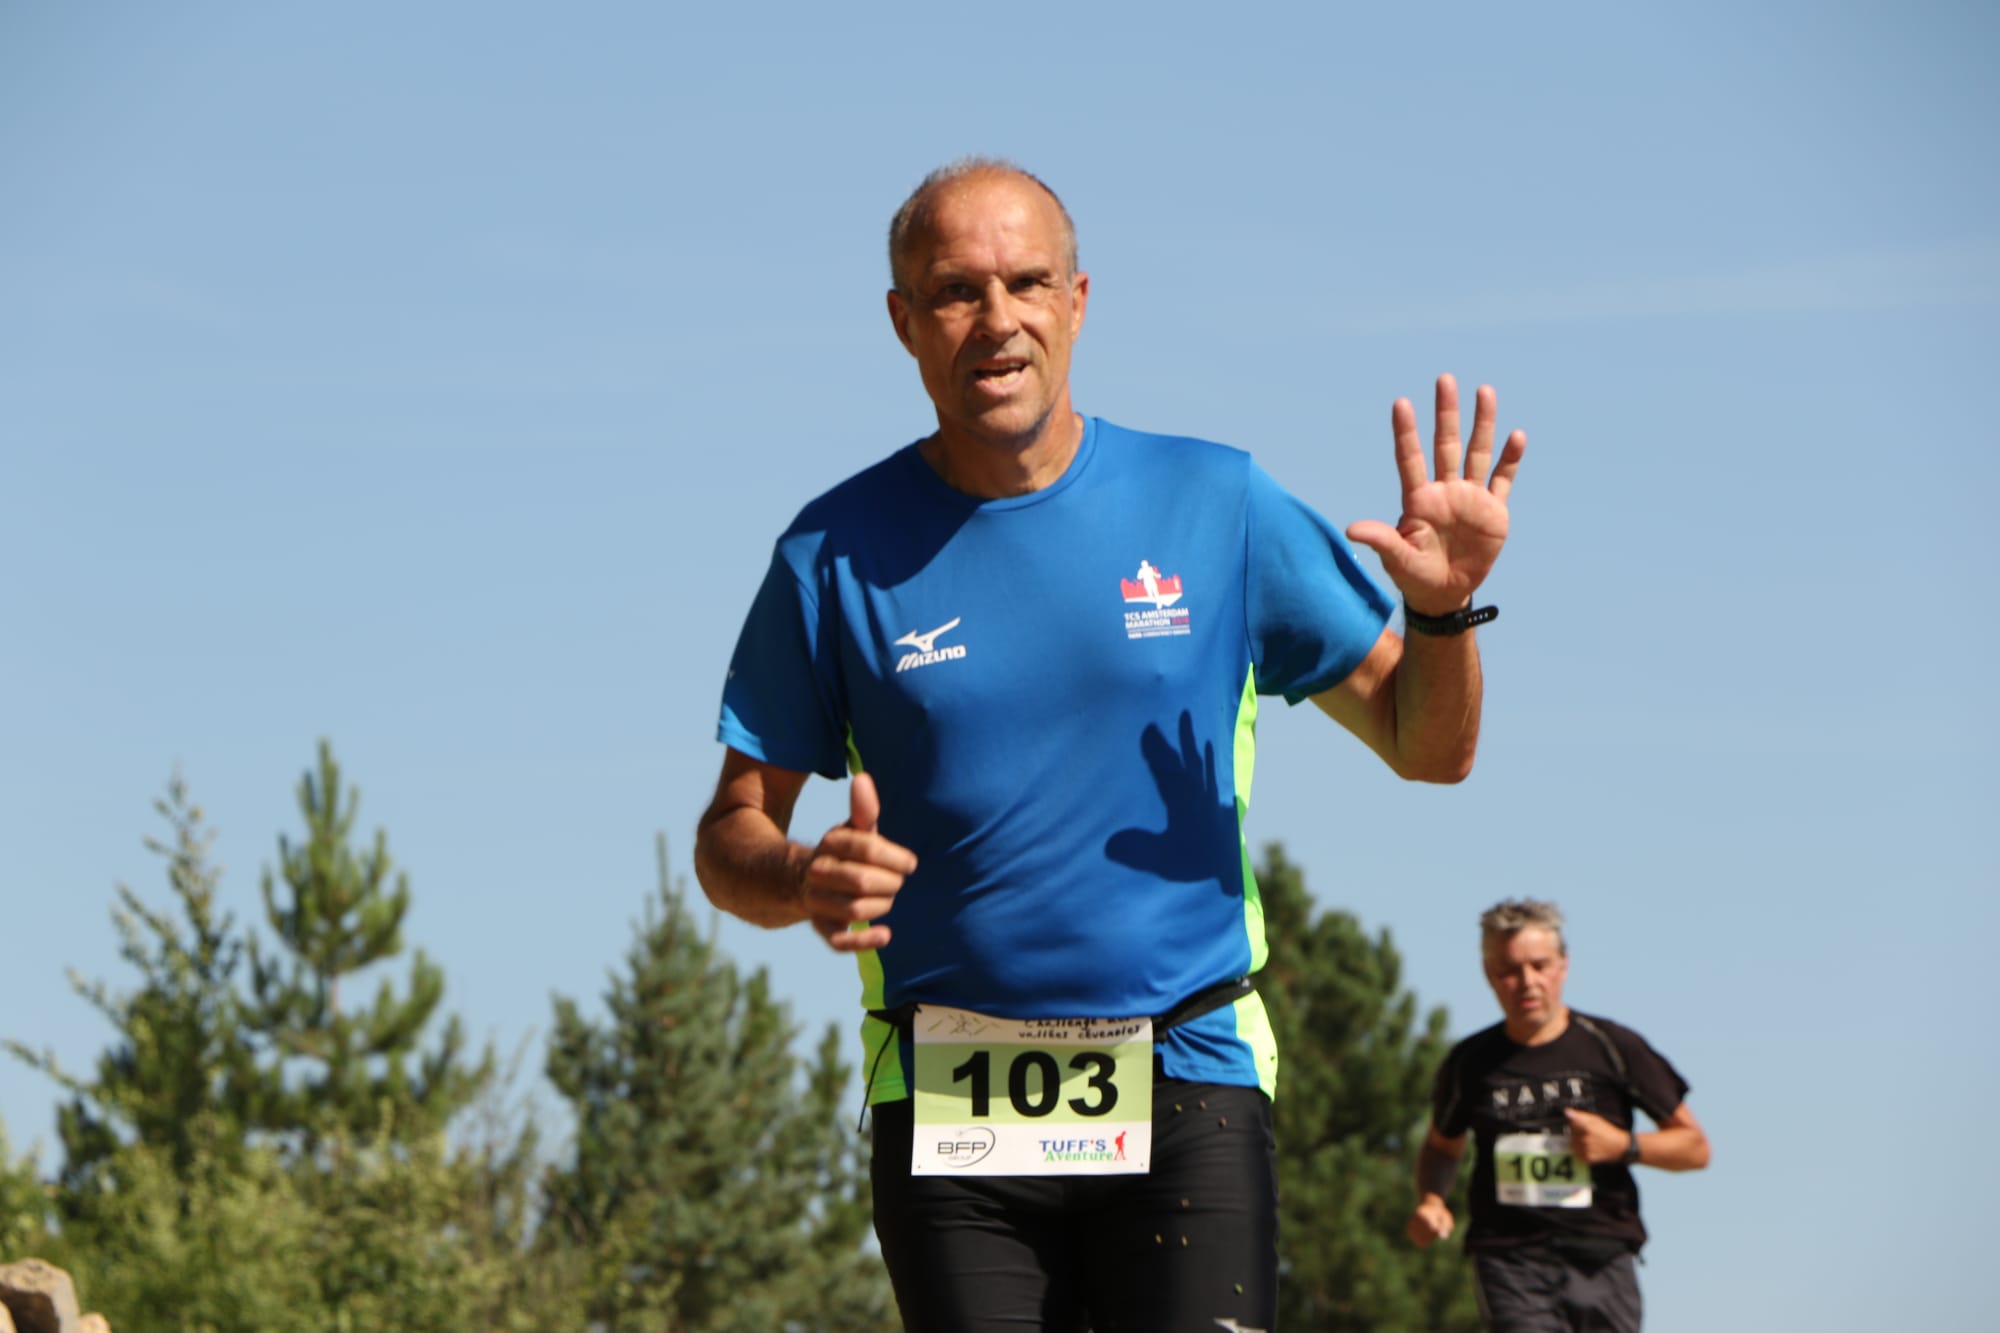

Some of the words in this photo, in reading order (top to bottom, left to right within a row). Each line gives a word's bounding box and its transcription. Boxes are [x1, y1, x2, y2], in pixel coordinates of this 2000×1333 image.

[1141, 608, 1189, 620] AMSTERDAM
[1125, 618, 1171, 629] MARATHON
[953, 1051, 1118, 1117] 103
[937, 1142, 987, 1154] BFP
[1039, 1138, 1107, 1153] TUFF'S
[1044, 1151, 1114, 1162] Aventure
[1507, 1155, 1574, 1182] 104
